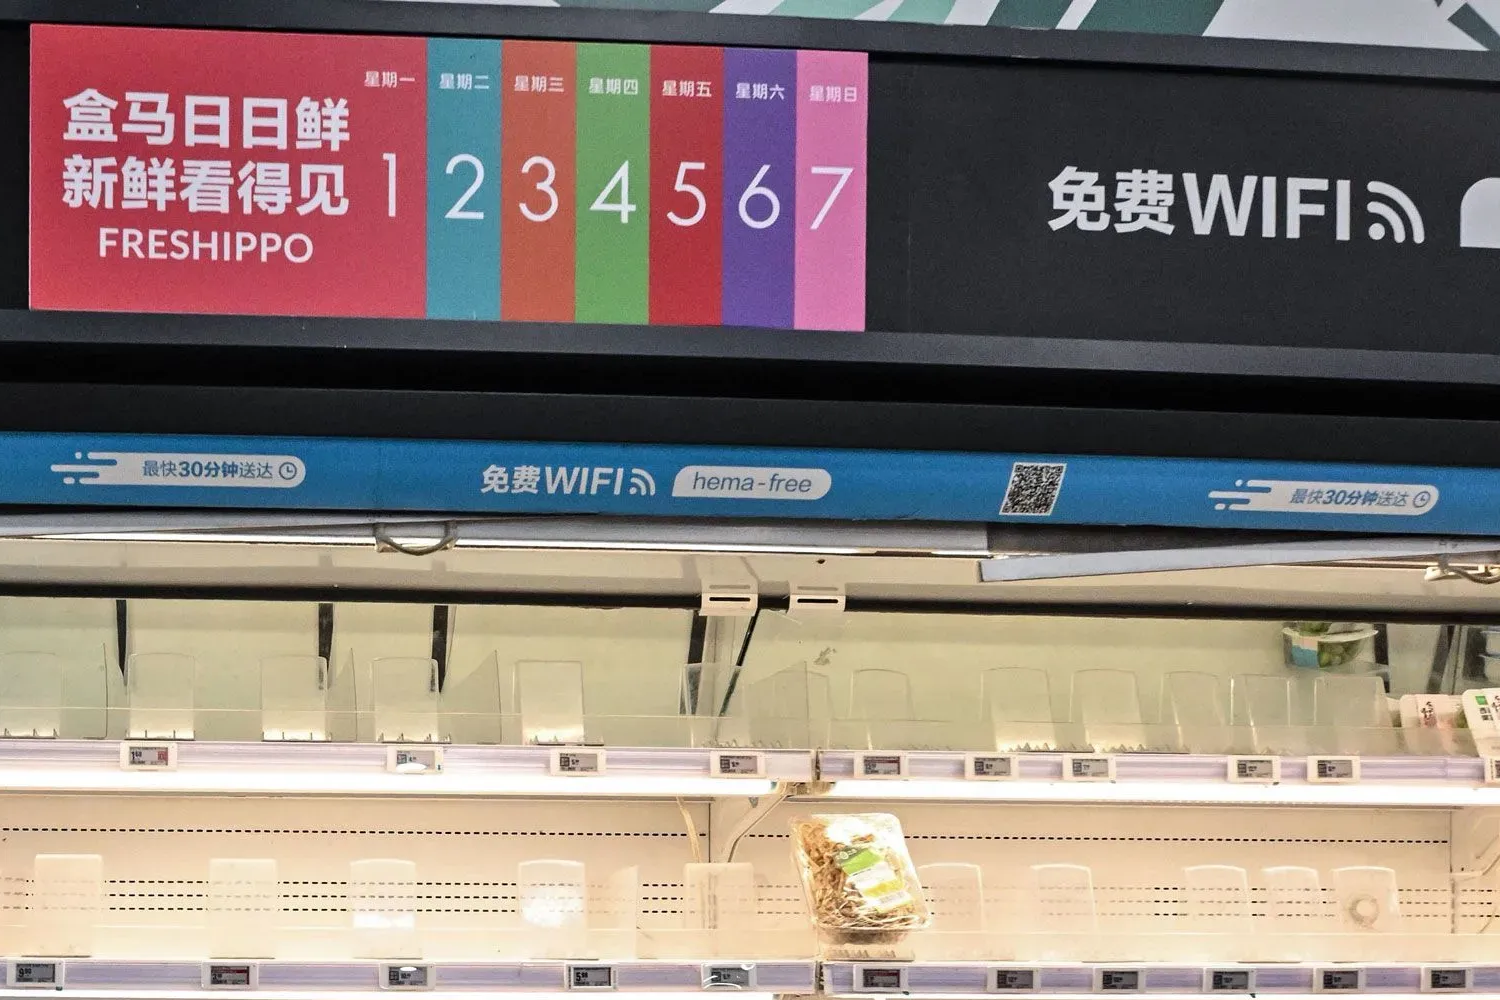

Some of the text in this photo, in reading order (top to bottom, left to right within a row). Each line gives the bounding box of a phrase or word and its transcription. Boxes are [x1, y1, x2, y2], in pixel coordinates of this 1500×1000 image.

[364, 71, 857, 103] 星期一 星期二 星期三 星期四 星期五 星期六 星期日
[63, 88, 350, 152] 盒马日日鲜
[62, 154, 349, 216] 新鲜看得见
[383, 152, 854, 230] 1 2 3 4 5 6 7
[1047, 165, 1351, 241] 免费WIFI
[99, 227, 313, 263] FRESHIPPO
[142, 460, 273, 479] 最快30分钟送达
[480, 464, 623, 496] 免费WIFI
[693, 472, 812, 493] hema-free
[1290, 488, 1409, 507] 最快30分钟送达
